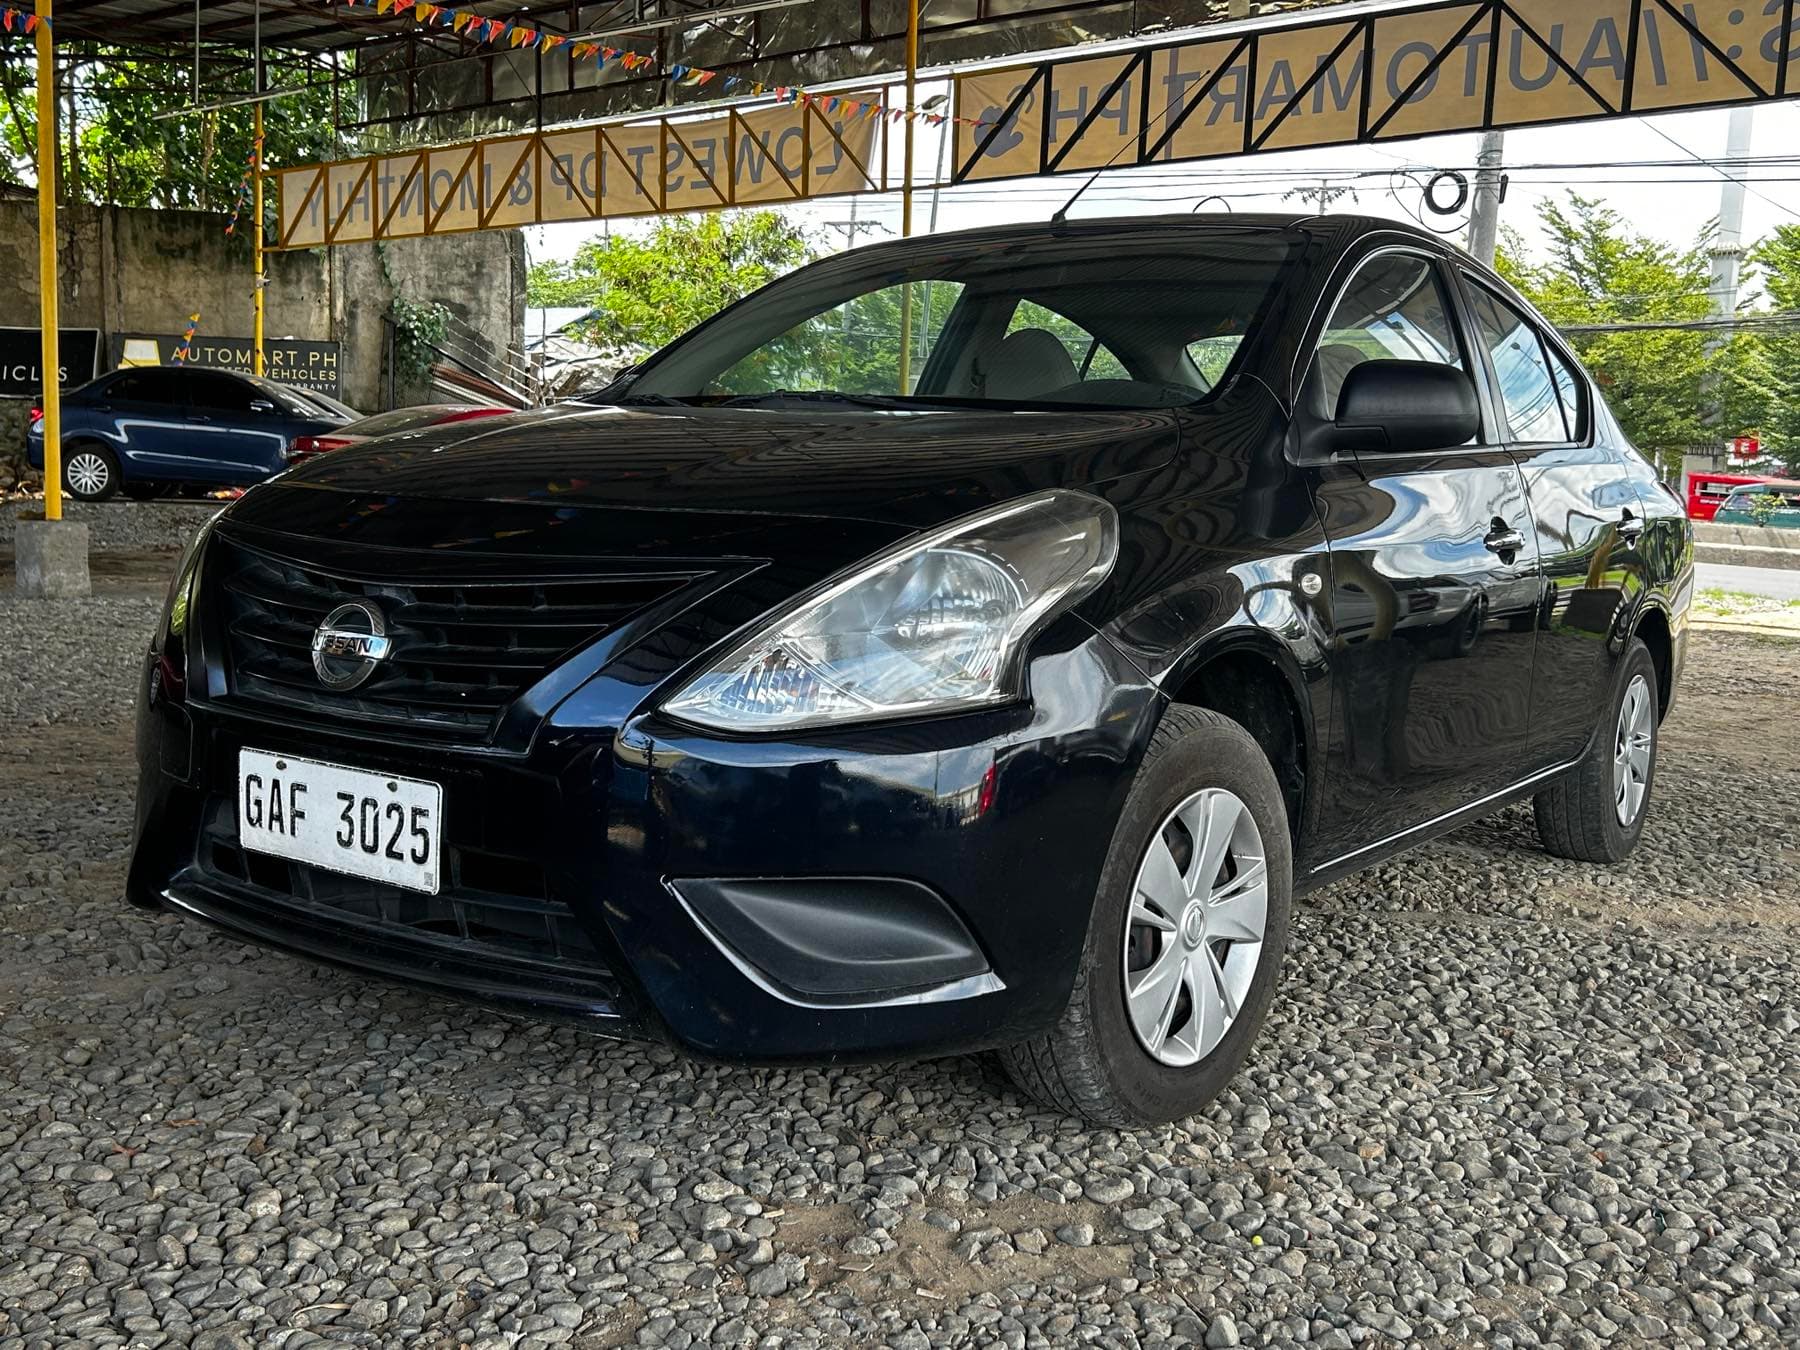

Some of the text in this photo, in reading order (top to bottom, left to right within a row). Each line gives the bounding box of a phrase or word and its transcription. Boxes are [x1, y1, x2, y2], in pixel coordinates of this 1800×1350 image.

[2, 364, 68, 382] ICLS
[262, 368, 337, 381] VEHICLES
[280, 381, 337, 392] ARRANTY
[245, 773, 431, 866] GAF 3025
